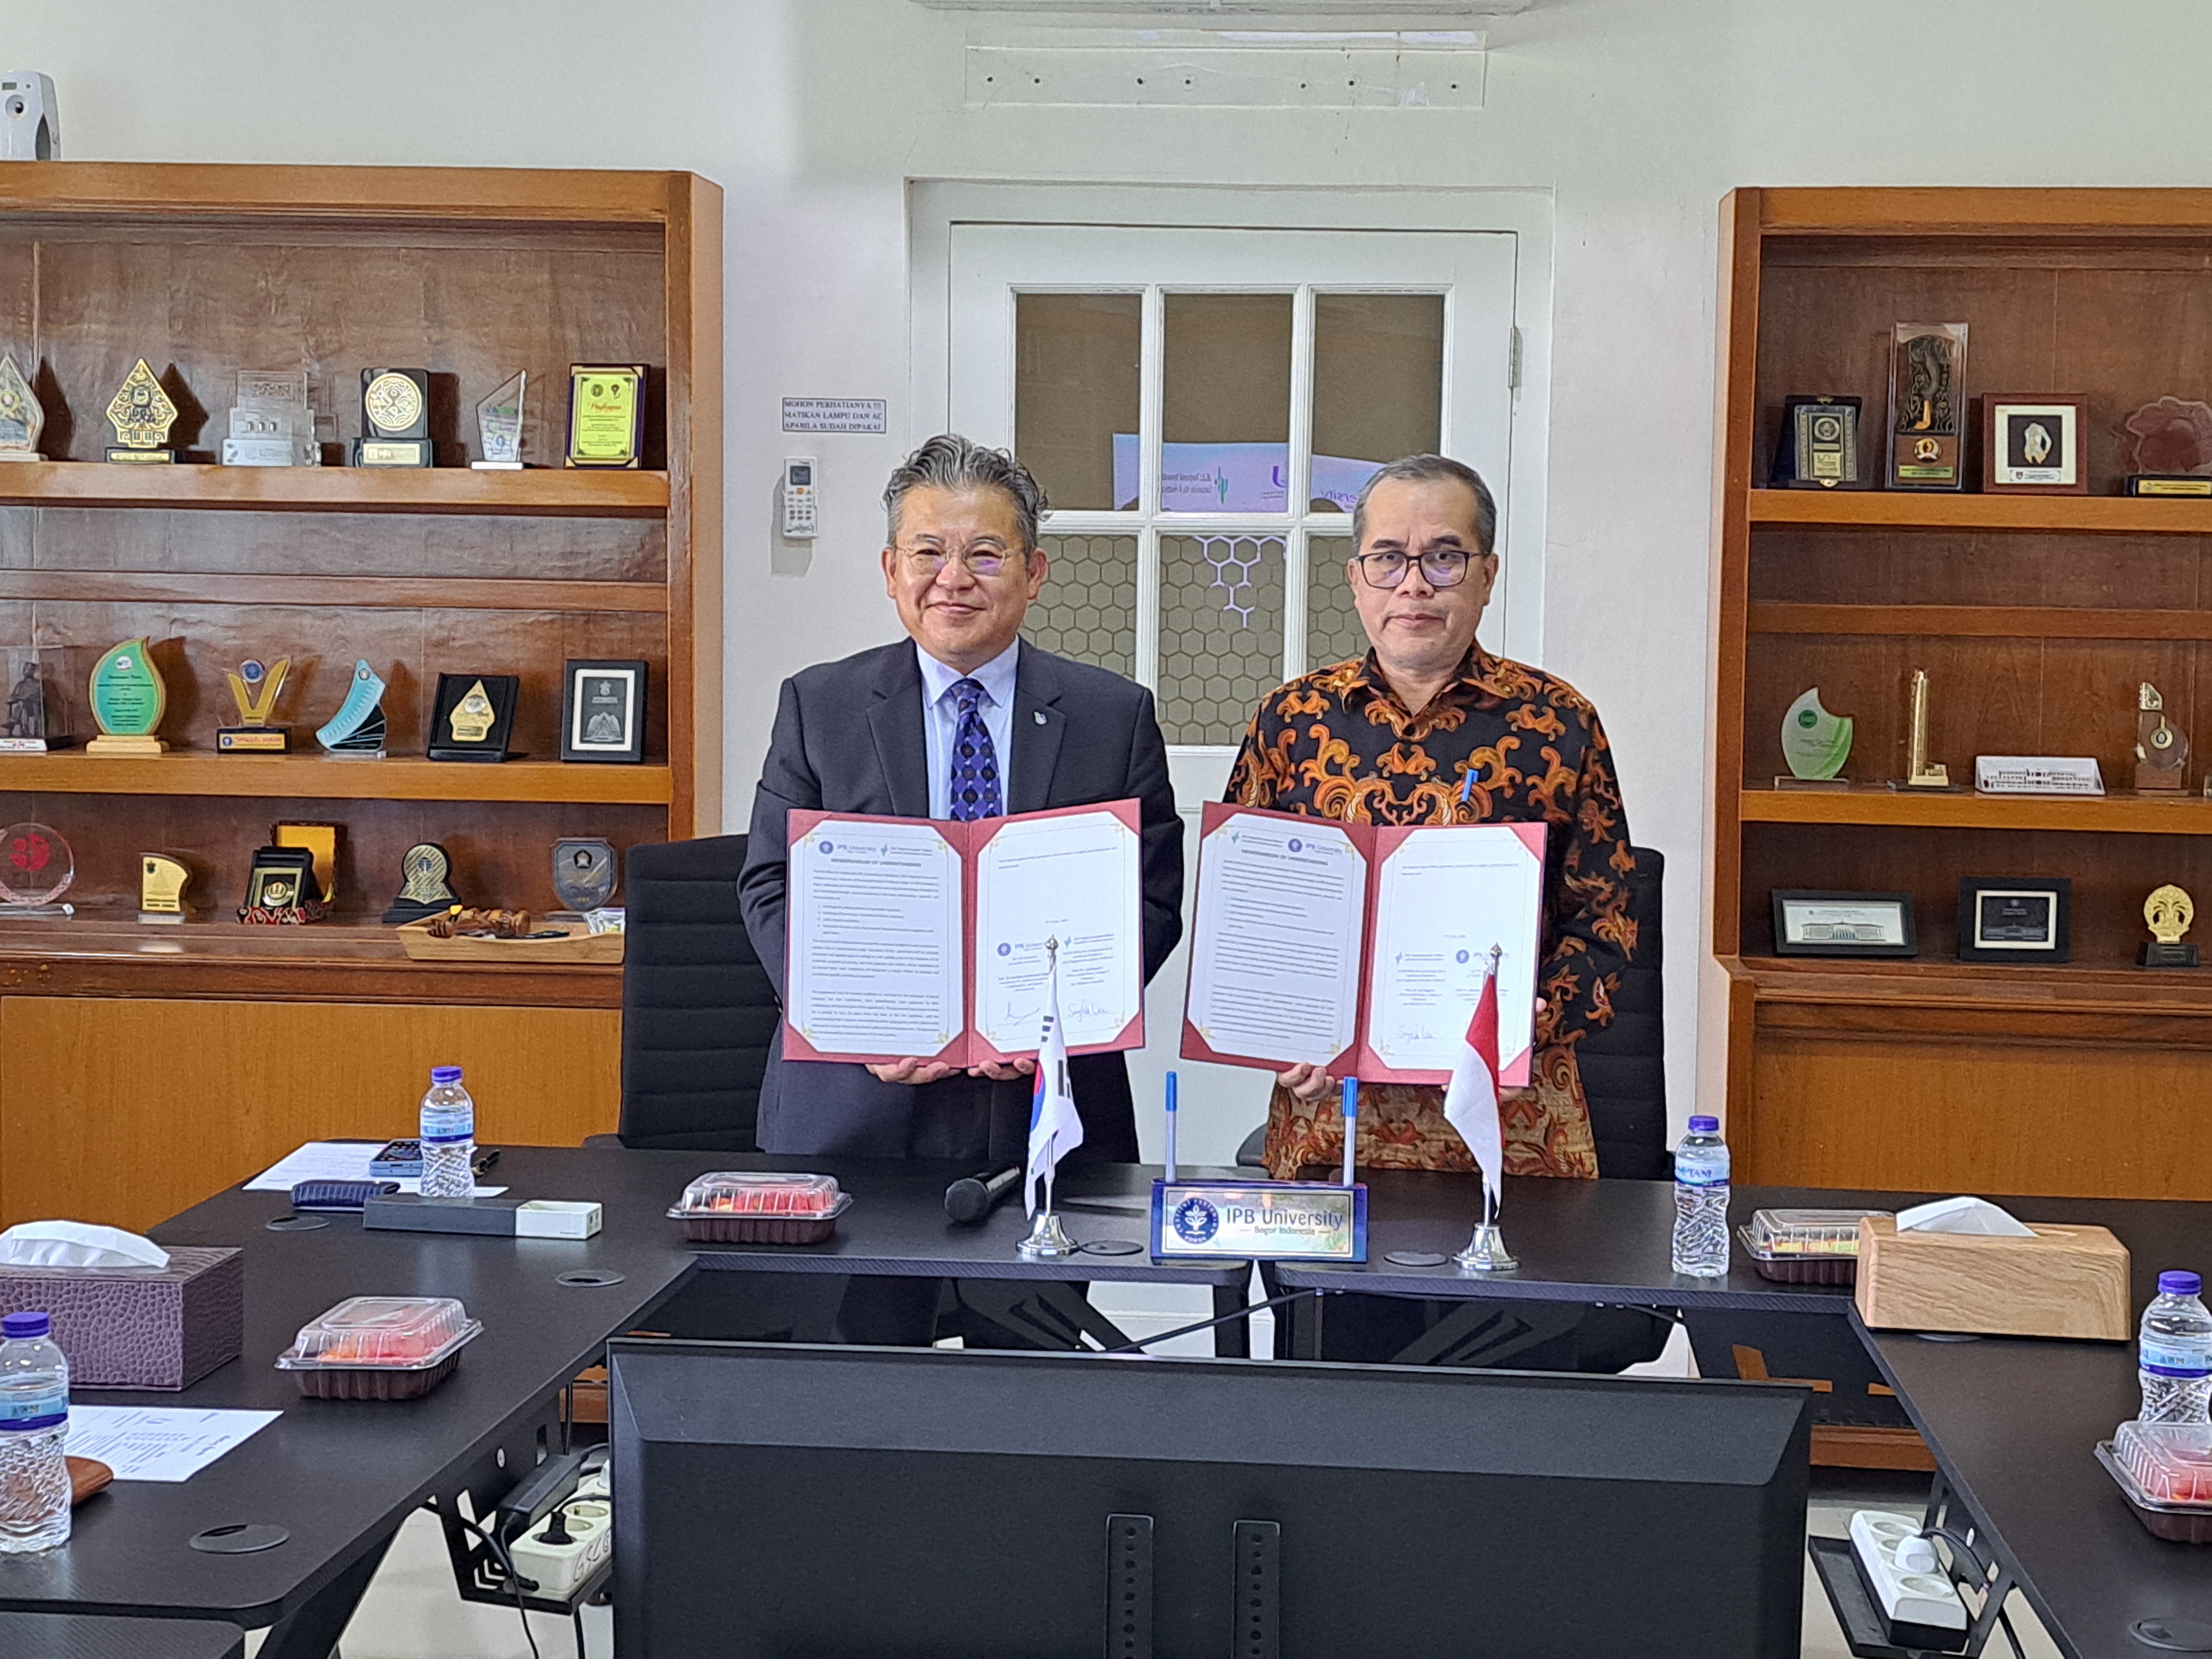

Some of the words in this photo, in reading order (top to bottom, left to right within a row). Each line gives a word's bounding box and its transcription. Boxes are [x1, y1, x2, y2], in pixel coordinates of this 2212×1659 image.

[1227, 1208, 1255, 1225] IPB
[1262, 1208, 1344, 1231] University
[1254, 1226, 1277, 1236] Bogor
[1279, 1227, 1316, 1236] Indonesia
